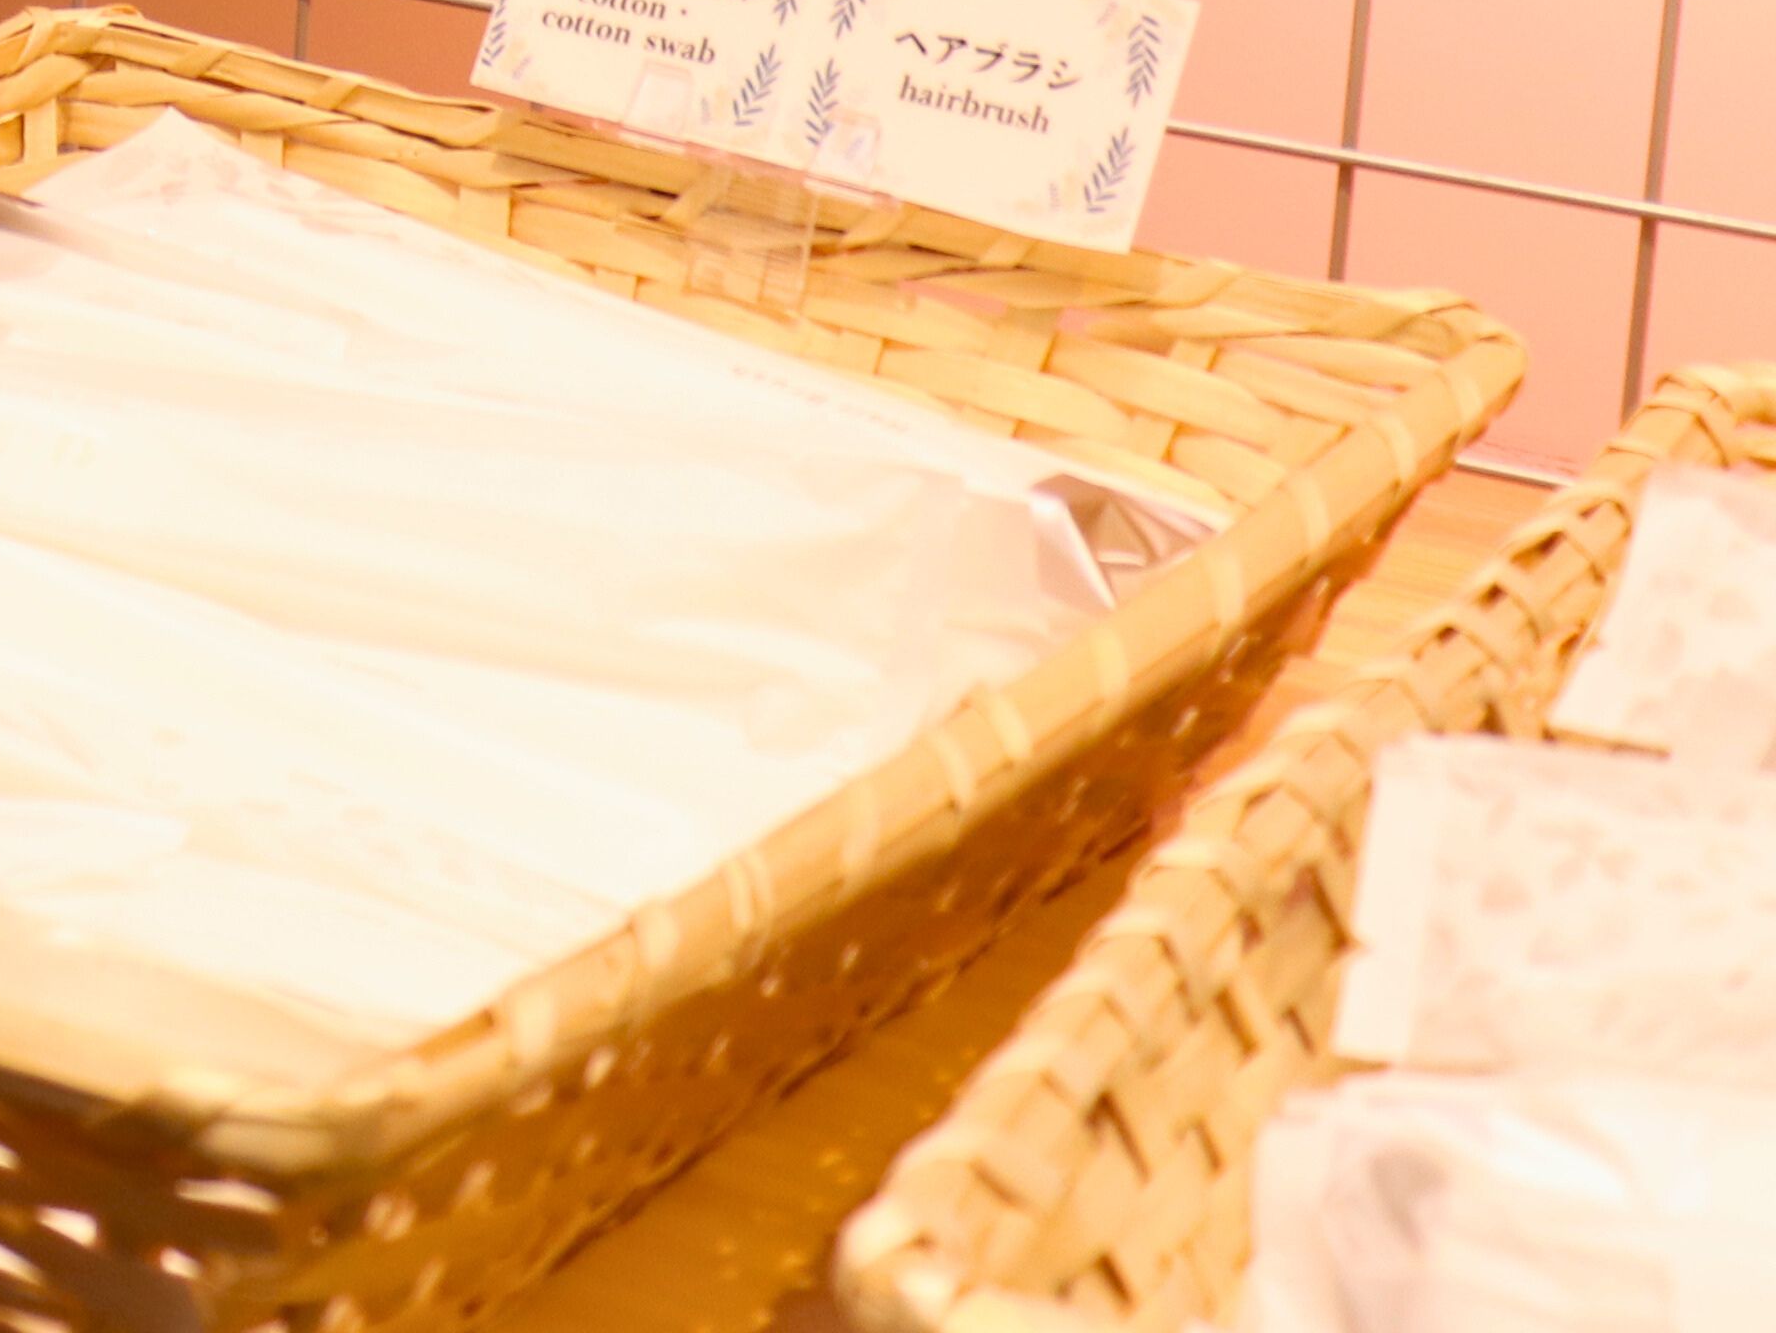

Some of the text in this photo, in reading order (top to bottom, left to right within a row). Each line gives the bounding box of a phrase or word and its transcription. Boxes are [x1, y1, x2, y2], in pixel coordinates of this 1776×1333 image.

[541, 9, 717, 66] cotton swab
[894, 31, 1084, 91] ヘアブラシ
[898, 74, 1051, 134] hairbrush
